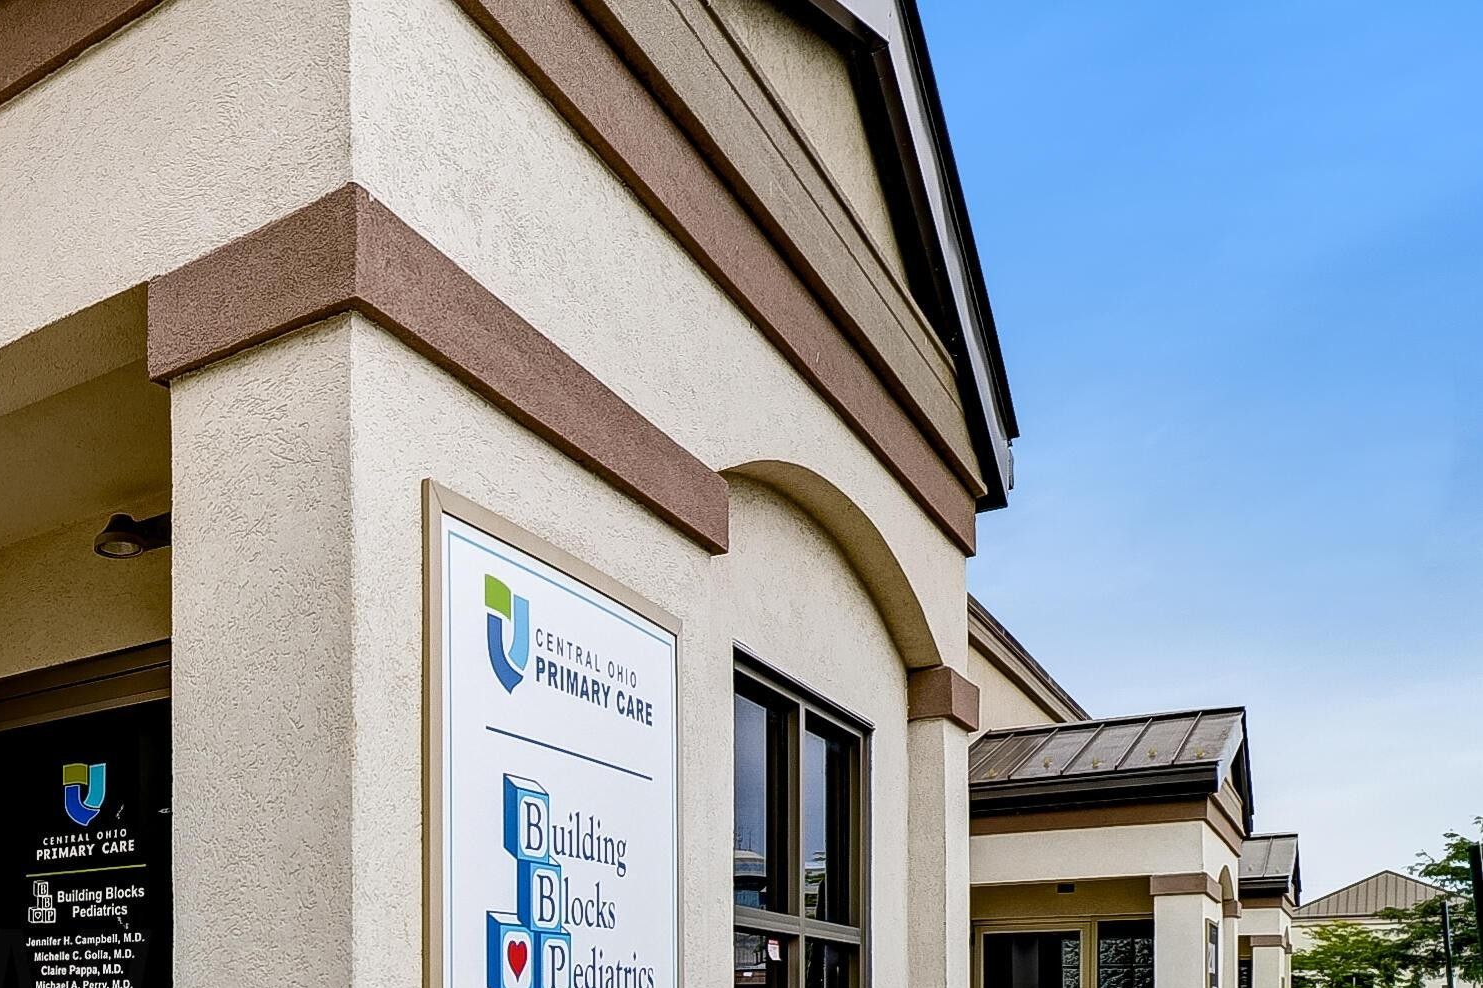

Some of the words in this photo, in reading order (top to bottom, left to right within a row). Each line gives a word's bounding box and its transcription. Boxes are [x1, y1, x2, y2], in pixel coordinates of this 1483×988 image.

[535, 628, 601, 673] CENTRAL
[608, 660, 637, 689] OHIO
[535, 655, 611, 709] PRIMARY
[616, 690, 653, 727] CARE
[42, 833, 90, 846] CENTRAL
[97, 828, 127, 840] OHIO
[523, 801, 627, 878] Building
[36, 843, 96, 861] PRIMARY
[102, 839, 135, 854] CARE
[57, 888, 103, 903] Building
[105, 884, 145, 900] Blocks
[537, 873, 616, 930] Blocks
[72, 902, 128, 918] Pediatrics
[25, 936, 62, 947] Jennifer
[63, 936, 73, 946] H.
[75, 933, 121, 947] Campbell,
[123, 932, 145, 943] M.D.
[33, 951, 70, 962] Michelle
[72, 950, 82, 960] C.
[113, 948, 135, 959] M.D.
[40, 965, 67, 976] Claire
[69, 964, 100, 977] Pappa,
[102, 964, 124, 975] M.D.
